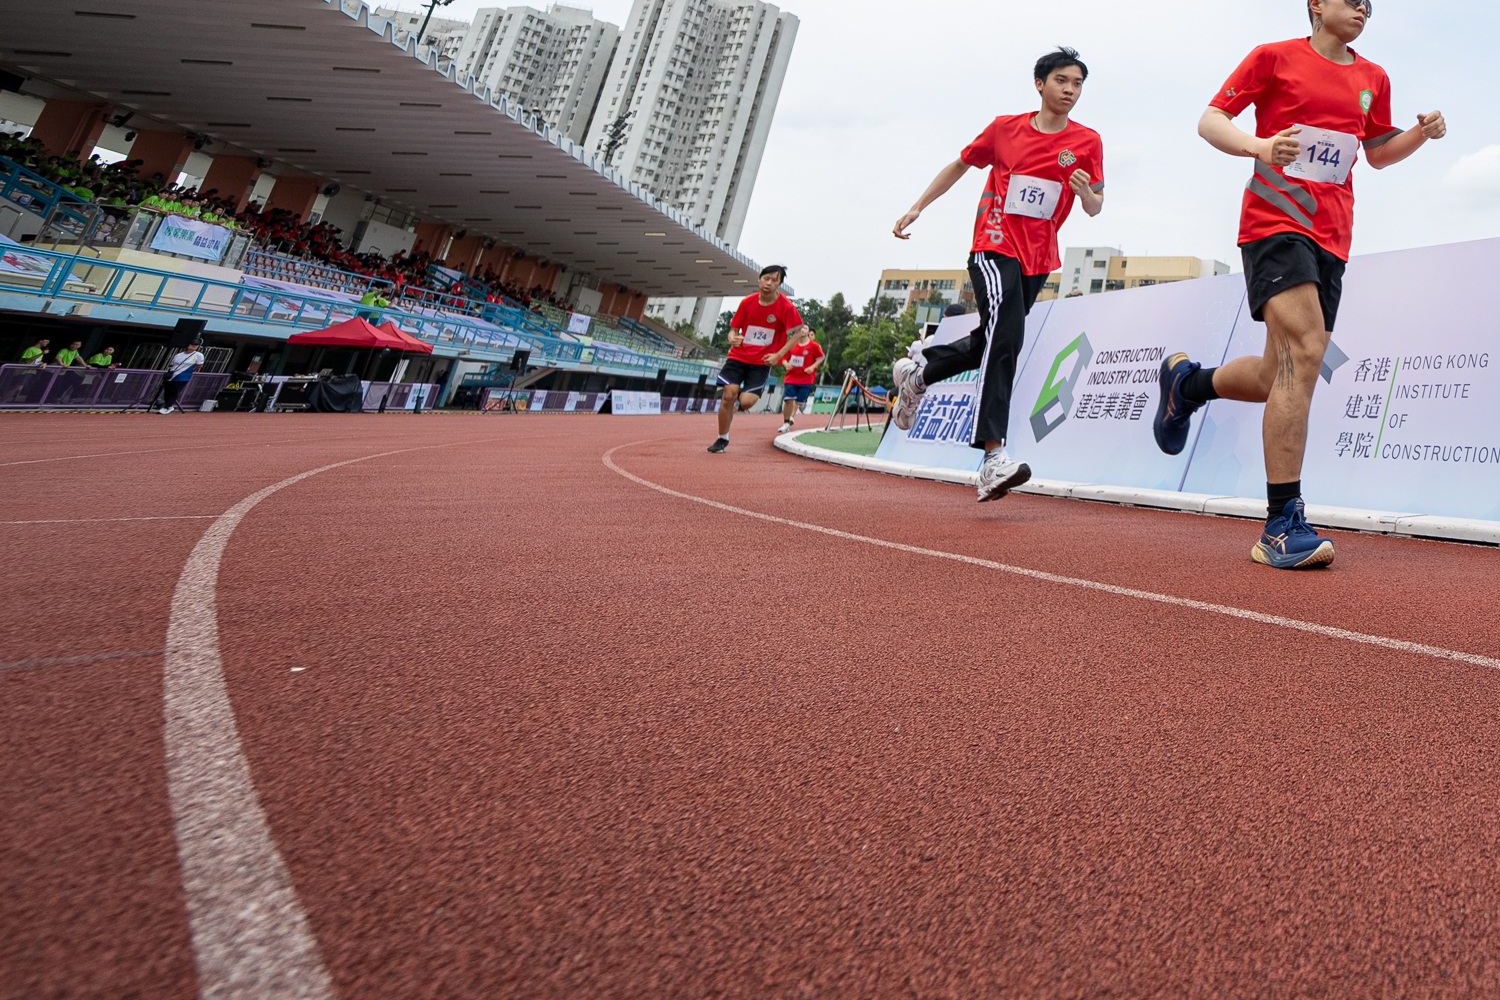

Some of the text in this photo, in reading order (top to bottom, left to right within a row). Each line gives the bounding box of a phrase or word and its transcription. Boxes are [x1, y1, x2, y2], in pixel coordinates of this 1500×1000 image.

[1307, 144, 1341, 168] 144
[1020, 188, 1045, 206] 151
[753, 331, 767, 341] 124
[1095, 346, 1167, 365] CONSTRUCTION
[1402, 353, 1489, 370] HONG KONG
[1087, 370, 1133, 385] INDUSTRY
[1354, 357, 1391, 383] 香港
[1395, 383, 1471, 399] INSTITUTE
[1073, 392, 1150, 421] 建造業議會
[1343, 394, 1383, 419] 建造
[1389, 413, 1408, 429] OF
[1334, 431, 1375, 459] 學院
